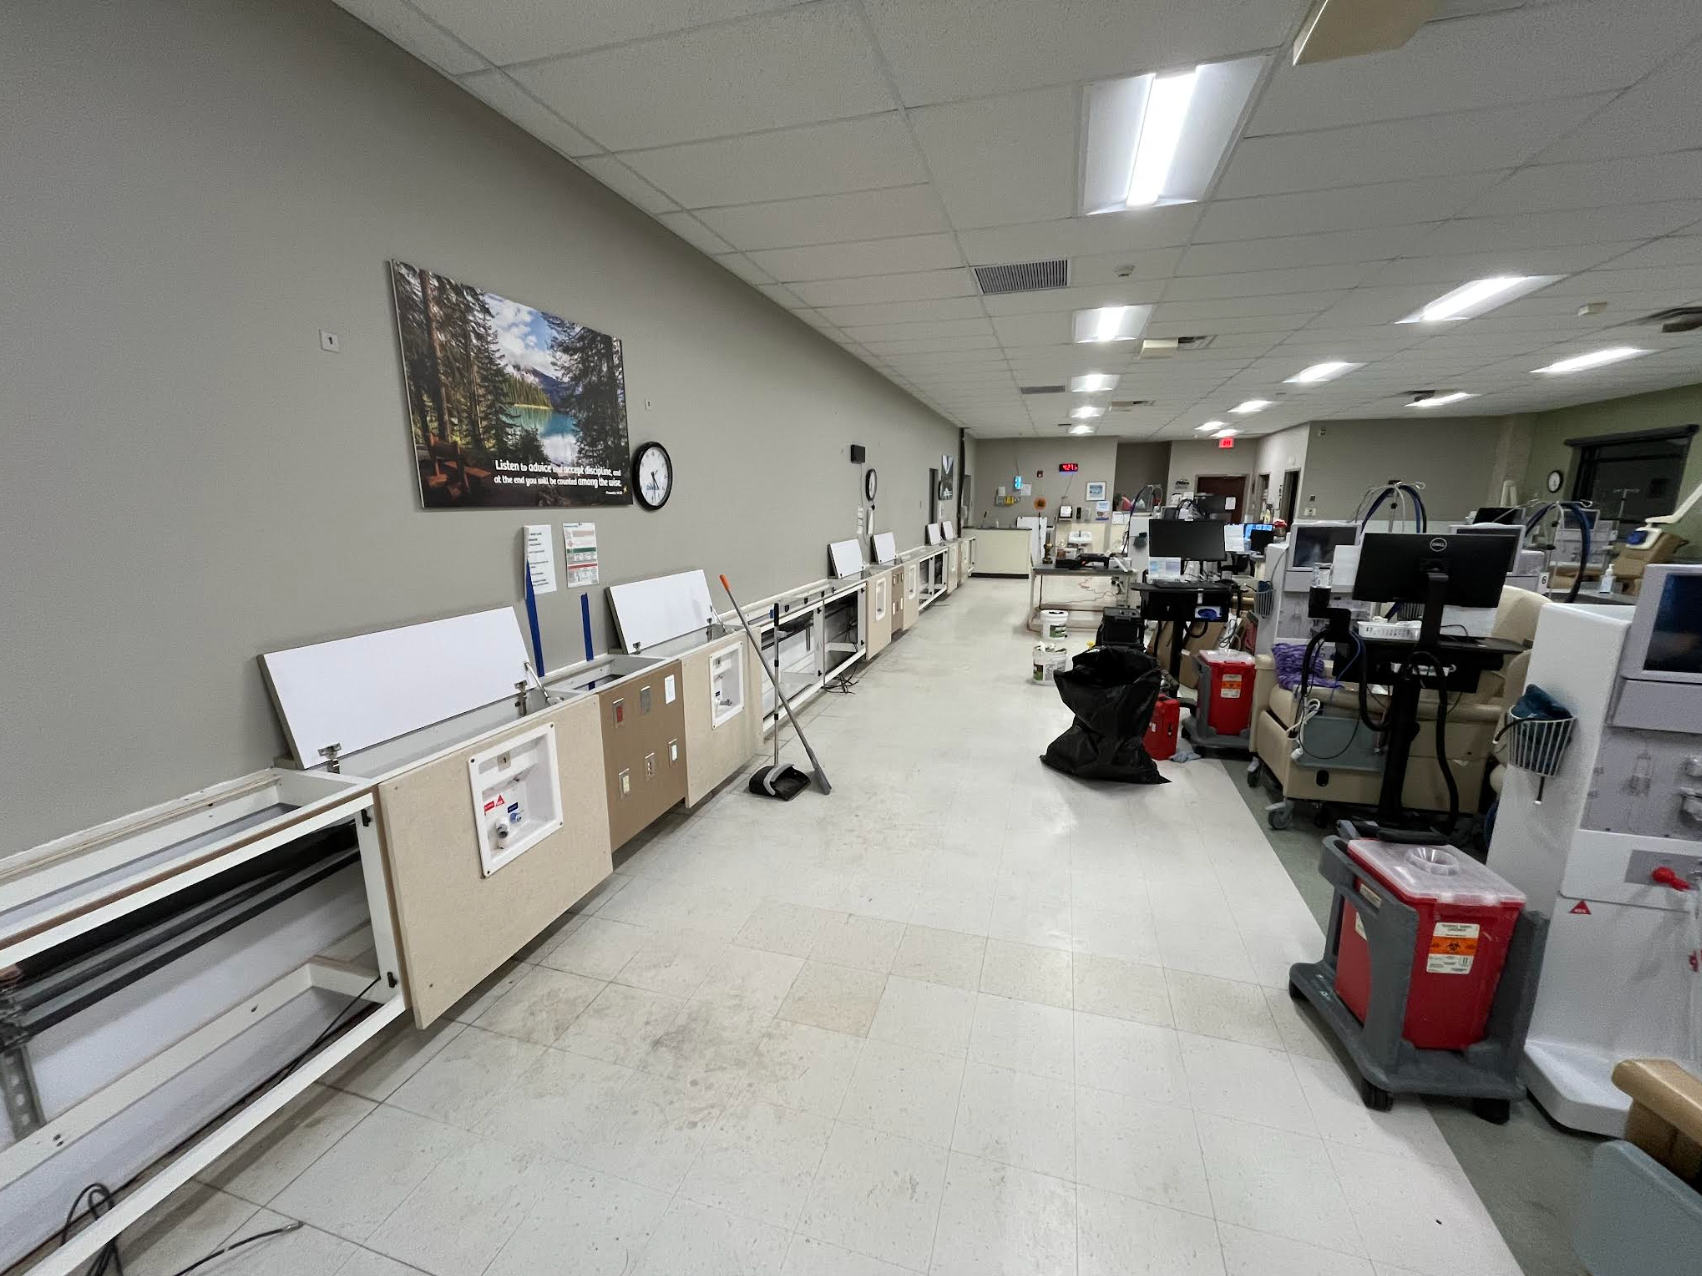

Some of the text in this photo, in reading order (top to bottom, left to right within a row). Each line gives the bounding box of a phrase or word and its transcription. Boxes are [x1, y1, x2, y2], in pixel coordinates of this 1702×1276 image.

[495, 459, 519, 471] Listen
[520, 463, 528, 471] to
[528, 462, 552, 472] advice
[564, 466, 585, 476] accept
[585, 466, 613, 477] discipline,
[494, 475, 502, 484] at
[502, 475, 513, 484] the
[513, 476, 526, 484] end
[526, 477, 538, 487] you
[537, 477, 550, 485] will
[549, 477, 557, 485] be
[578, 478, 598, 489] among
[599, 478, 608, 487] the
[609, 477, 622, 487] wise.
[1541, 576, 1547, 585] 6
